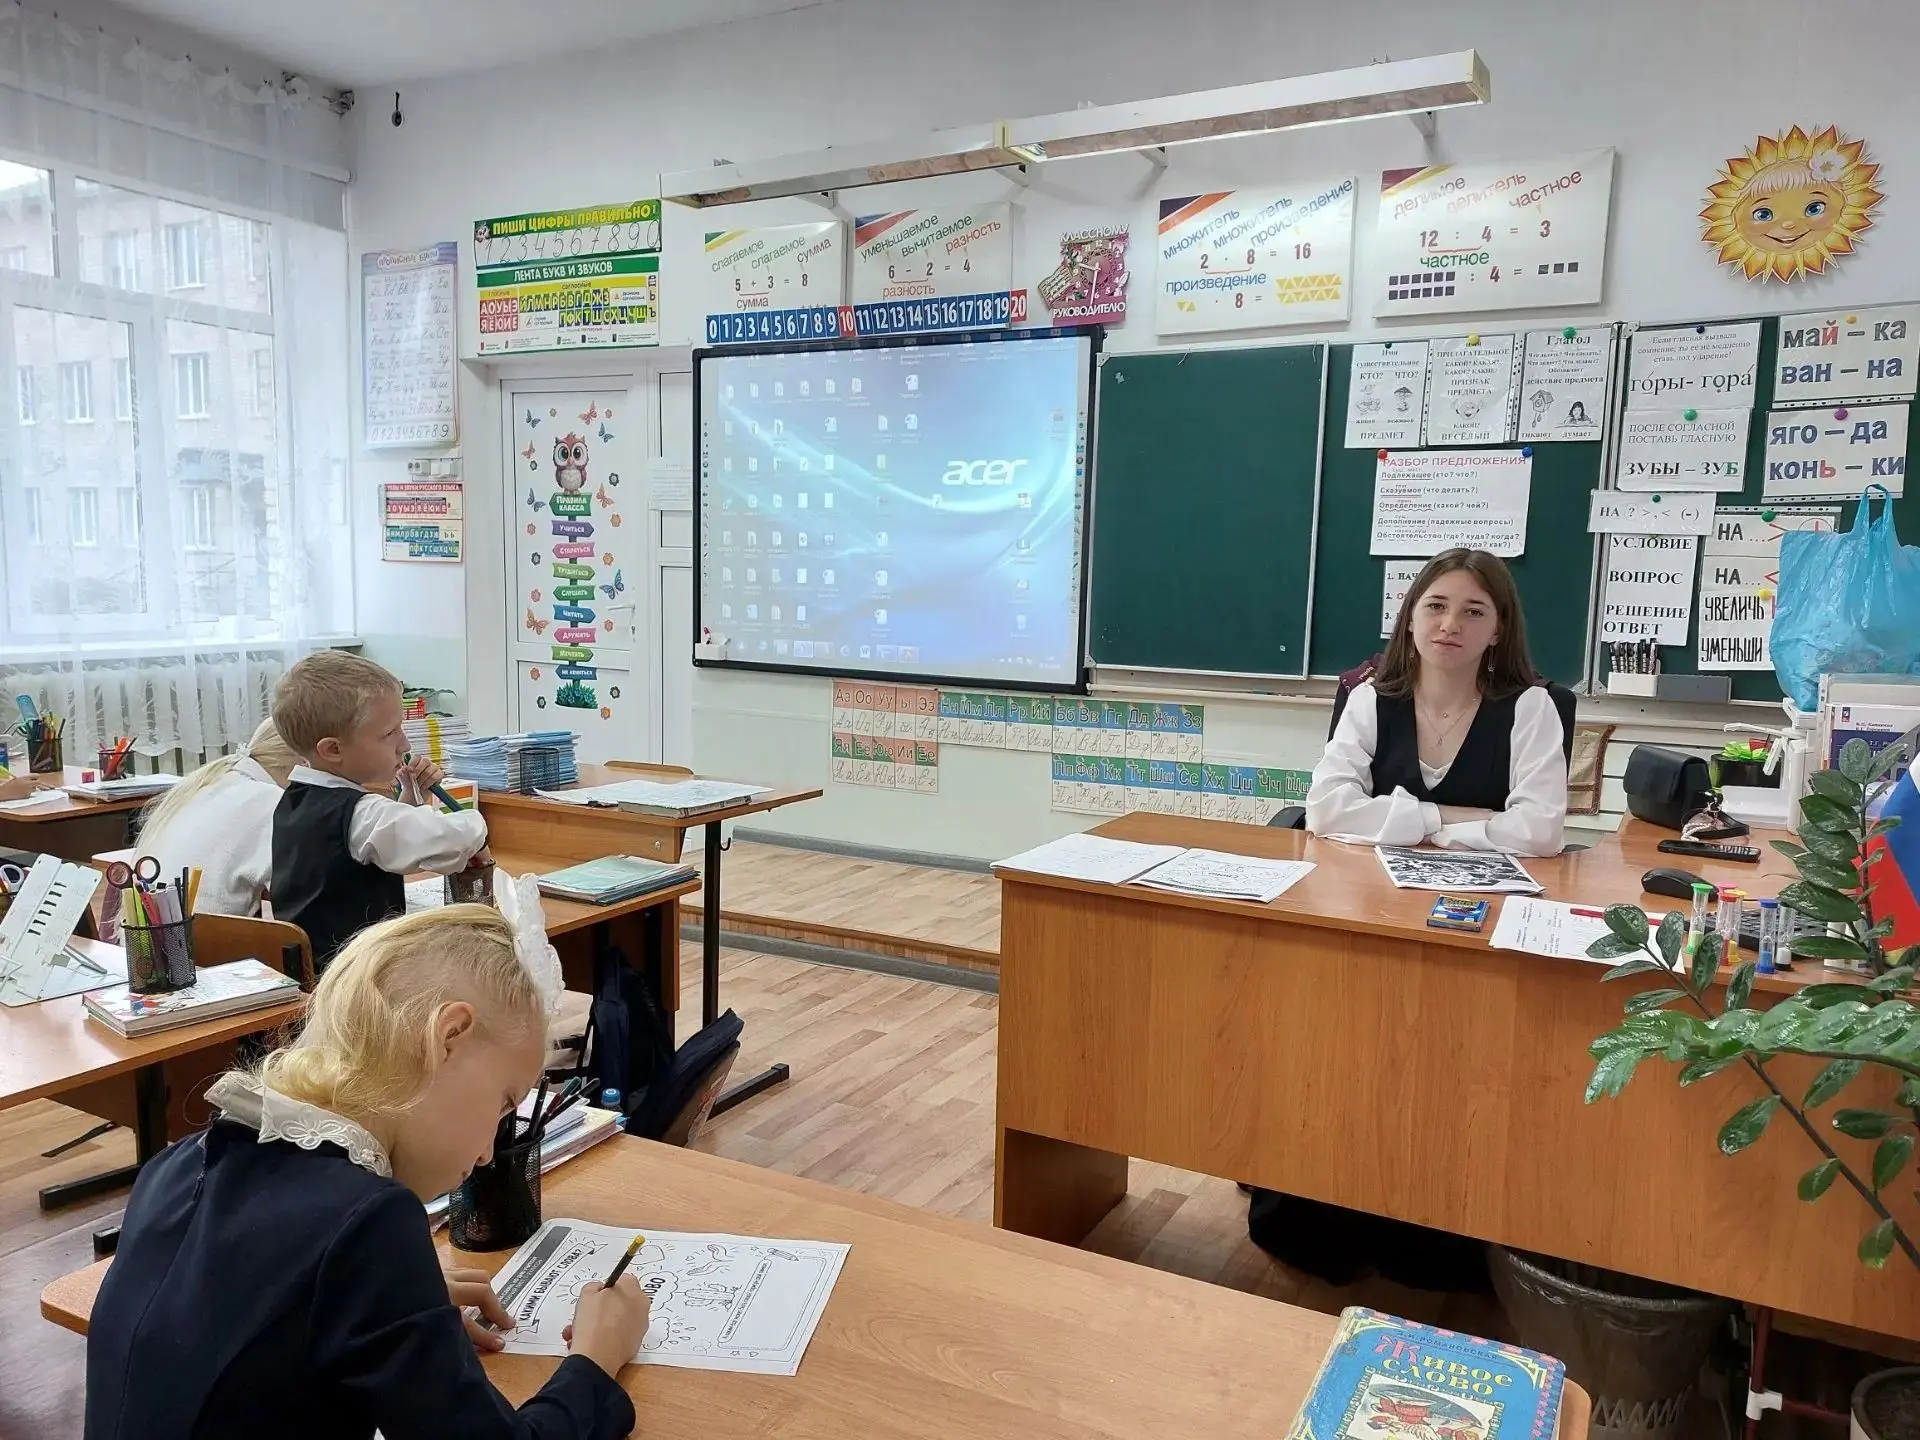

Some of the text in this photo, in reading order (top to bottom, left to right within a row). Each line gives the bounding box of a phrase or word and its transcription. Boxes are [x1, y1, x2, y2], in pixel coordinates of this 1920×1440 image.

[1394, 170, 1582, 220] делимое делитель частное
[493, 220, 527, 235] ПИШИ
[528, 216, 575, 231] ЦИФРЫ
[1163, 179, 1353, 260] множитель множитель произведение
[860, 214, 1001, 263] уменьшаемое вычитаемое разность
[1060, 223, 1129, 242] КЛАССНОМУ
[1420, 220, 1550, 248] 12 4 3
[711, 236, 832, 272] слагаемое слагаемое сумма
[1200, 242, 1311, 270] 2 8 16
[1420, 251, 1490, 269] частное
[514, 261, 613, 282] ЛЕНТА БУКВ И ЗВУКОВ
[888, 259, 971, 279] 6 2 4
[1490, 266, 1500, 282] 4
[735, 273, 808, 291] 5 3 8
[1165, 272, 1267, 296] произведение
[882, 283, 936, 301] разность
[1235, 292, 1243, 309] 8
[737, 296, 769, 311] сумма
[1053, 302, 1126, 319] РУКОВОДИТЕЛЮ
[709, 294, 1026, 339] 0 1 2 3 4 5 6 7 8 9 10 11 12 13 14 15 16 17 18 19 20
[1547, 335, 1591, 346] Глагол
[1784, 319, 1907, 349] май ка
[1360, 371, 1419, 380] КТО? ЧТО?
[1781, 356, 1902, 385] ван на
[1451, 378, 1490, 386] ПРИЗНАК
[1360, 431, 1405, 440] ПРЕДМЕТ
[1629, 420, 1735, 433] ПОСЛЕ СОГЛАСНОЙ
[1770, 421, 1888, 446] яго да
[1629, 433, 1737, 444] ПОСТАВЬ ГЛАСНУЮ
[1383, 457, 1526, 467] РАЗБОР ПРЕДЛОЖЕНИЯ
[1625, 461, 1739, 478] ЗУБЫ ЗУБ
[1769, 455, 1905, 481] конь ки
[942, 458, 1028, 486] acer
[1380, 487, 1421, 495] Сказуемое
[1379, 502, 1432, 510] Определение
[1600, 507, 1619, 517] НА
[1378, 518, 1426, 526] Дополнение
[1473, 518, 1514, 526] вопросы)
[1377, 532, 1442, 540] Обстоятельство
[1718, 523, 1743, 541] НА
[1612, 537, 1692, 550] УСЛОВИЕ
[1609, 571, 1684, 585] ВОПРОС
[1715, 568, 1741, 585] НА
[1606, 604, 1688, 619] РЕШЕНИЕ
[1705, 597, 1764, 621] УВЕЛИЧЬ
[1604, 621, 1663, 635] ОТВЕТ
[1701, 637, 1762, 662] УМЕНЬШИ
[519, 1295, 541, 1321] КАКИМИ
[534, 1270, 562, 1294] БЫВАЮТ
[557, 1248, 584, 1270] СЛОВА?
